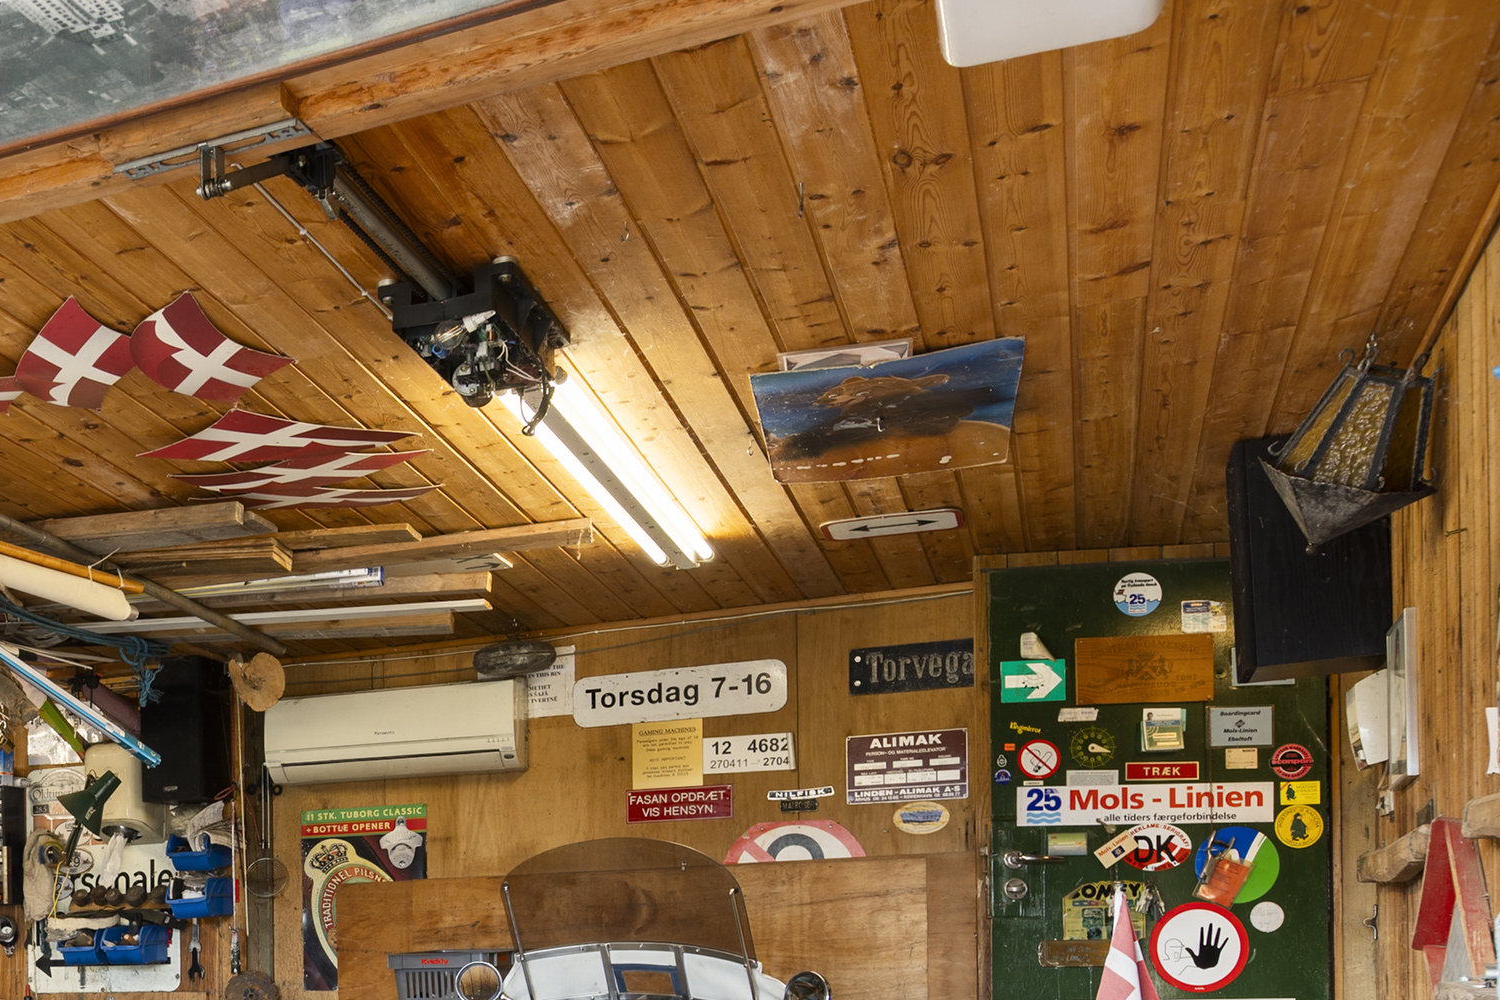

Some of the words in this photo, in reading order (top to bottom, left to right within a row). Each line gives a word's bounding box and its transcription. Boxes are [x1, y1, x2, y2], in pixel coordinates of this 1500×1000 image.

[1129, 593, 1146, 605] 25
[586, 682, 699, 710] Torsdag
[711, 672, 772, 699] 7-16
[639, 728, 664, 736] GAMING
[712, 740, 732, 755] 12
[748, 738, 789, 753] 4682
[870, 733, 942, 749] ALIMAK
[710, 758, 748, 770] 270411
[763, 756, 789, 767] 2704
[1143, 766, 1181, 776] TRÆK
[629, 794, 668, 805] FASAN
[672, 790, 730, 803] OPDRÆT.
[1026, 788, 1062, 812] 25
[1069, 786, 1145, 811] Mols
[1169, 785, 1264, 809] Linien
[317, 811, 337, 821] STK.
[340, 809, 380, 819] TUBORG
[383, 807, 422, 817] CLASSIC
[642, 807, 660, 817] VIS
[664, 805, 717, 816] HENSYN.
[1104, 813, 1121, 822] alle
[1124, 812, 1150, 821] tiders
[1153, 812, 1237, 823] færgeforbindelse
[352, 822, 390, 832] OPENER
[1130, 824, 1159, 836] REKLAME
[1134, 834, 1177, 863] DK
[322, 870, 352, 929] TRADITIONEL
